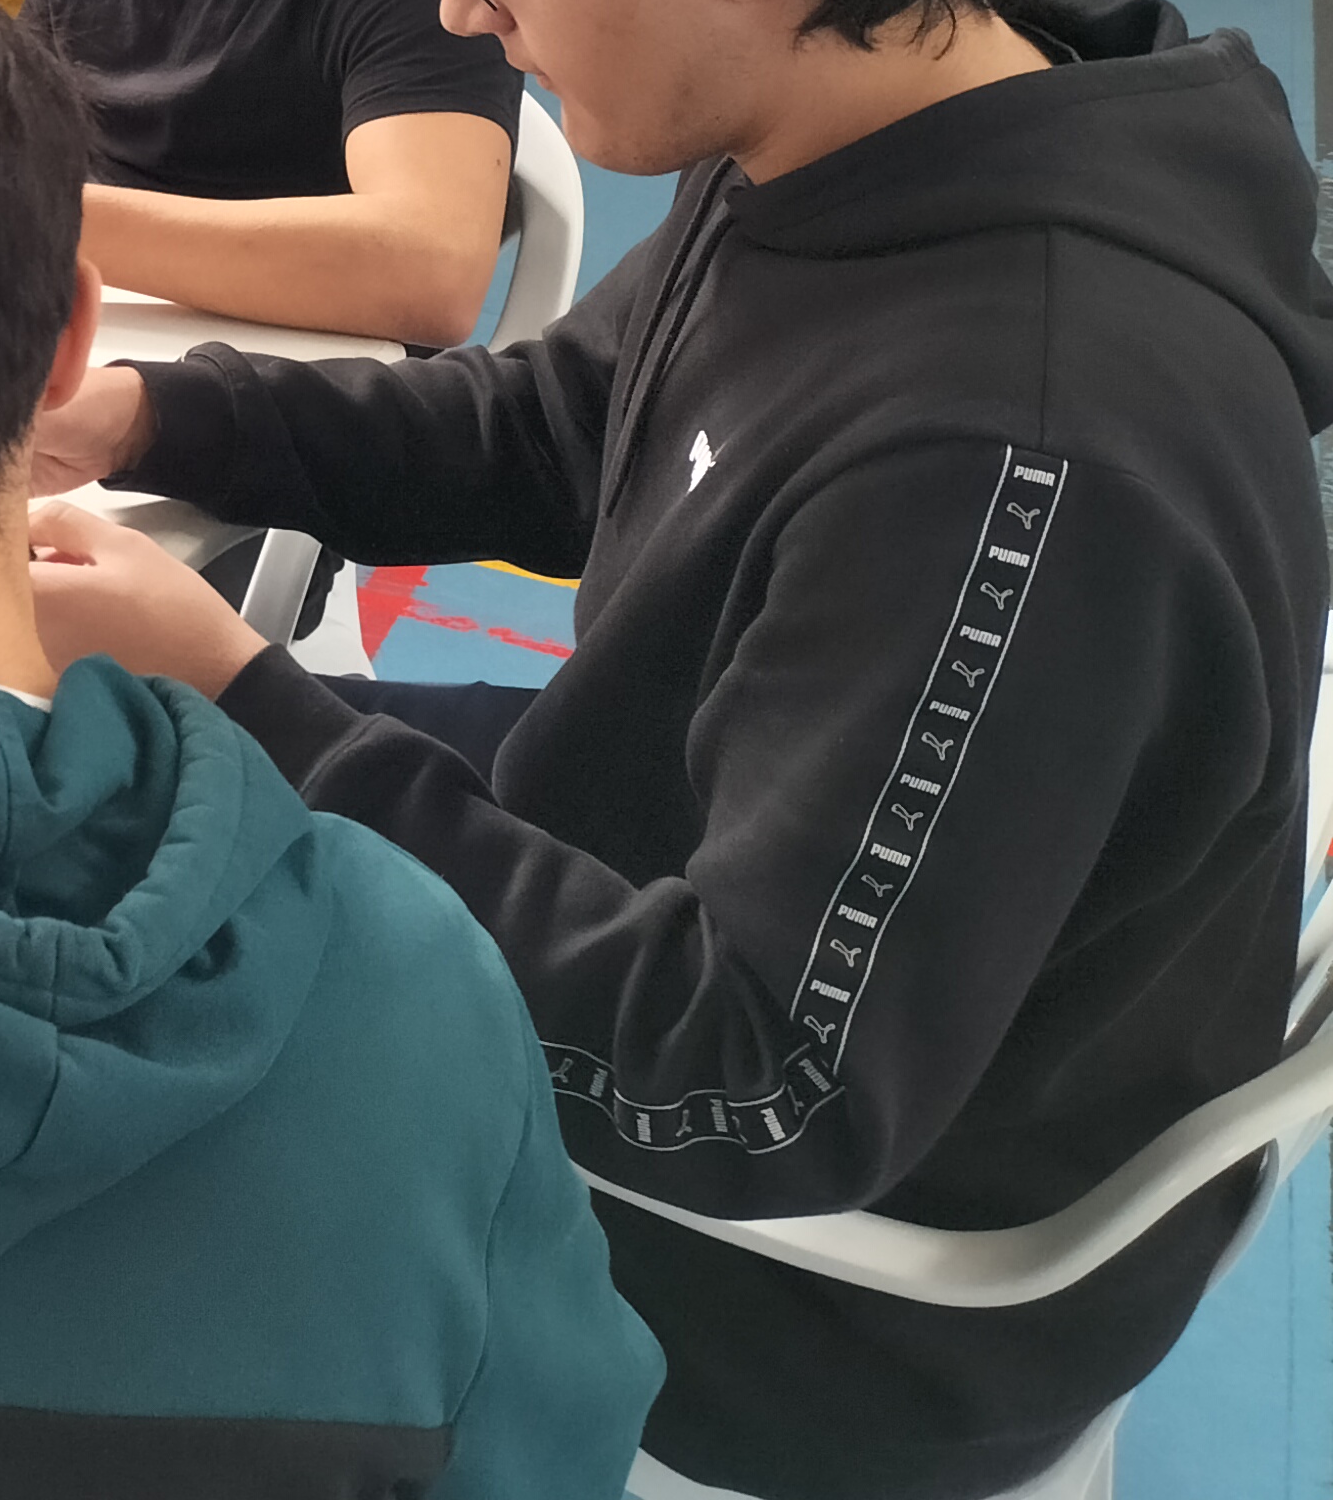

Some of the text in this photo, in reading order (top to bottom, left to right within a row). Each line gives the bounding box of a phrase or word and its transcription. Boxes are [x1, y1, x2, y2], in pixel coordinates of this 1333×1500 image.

[1013, 465, 1055, 487] PUMA
[988, 545, 1030, 568] PUMA
[959, 624, 1002, 648] PUMA
[929, 700, 971, 722] PUMA
[899, 773, 942, 796] PUMA
[869, 842, 912, 868] PUMA
[837, 904, 878, 929] PUMA
[809, 979, 851, 1003] PUMA
[798, 1058, 831, 1092] PUMA
